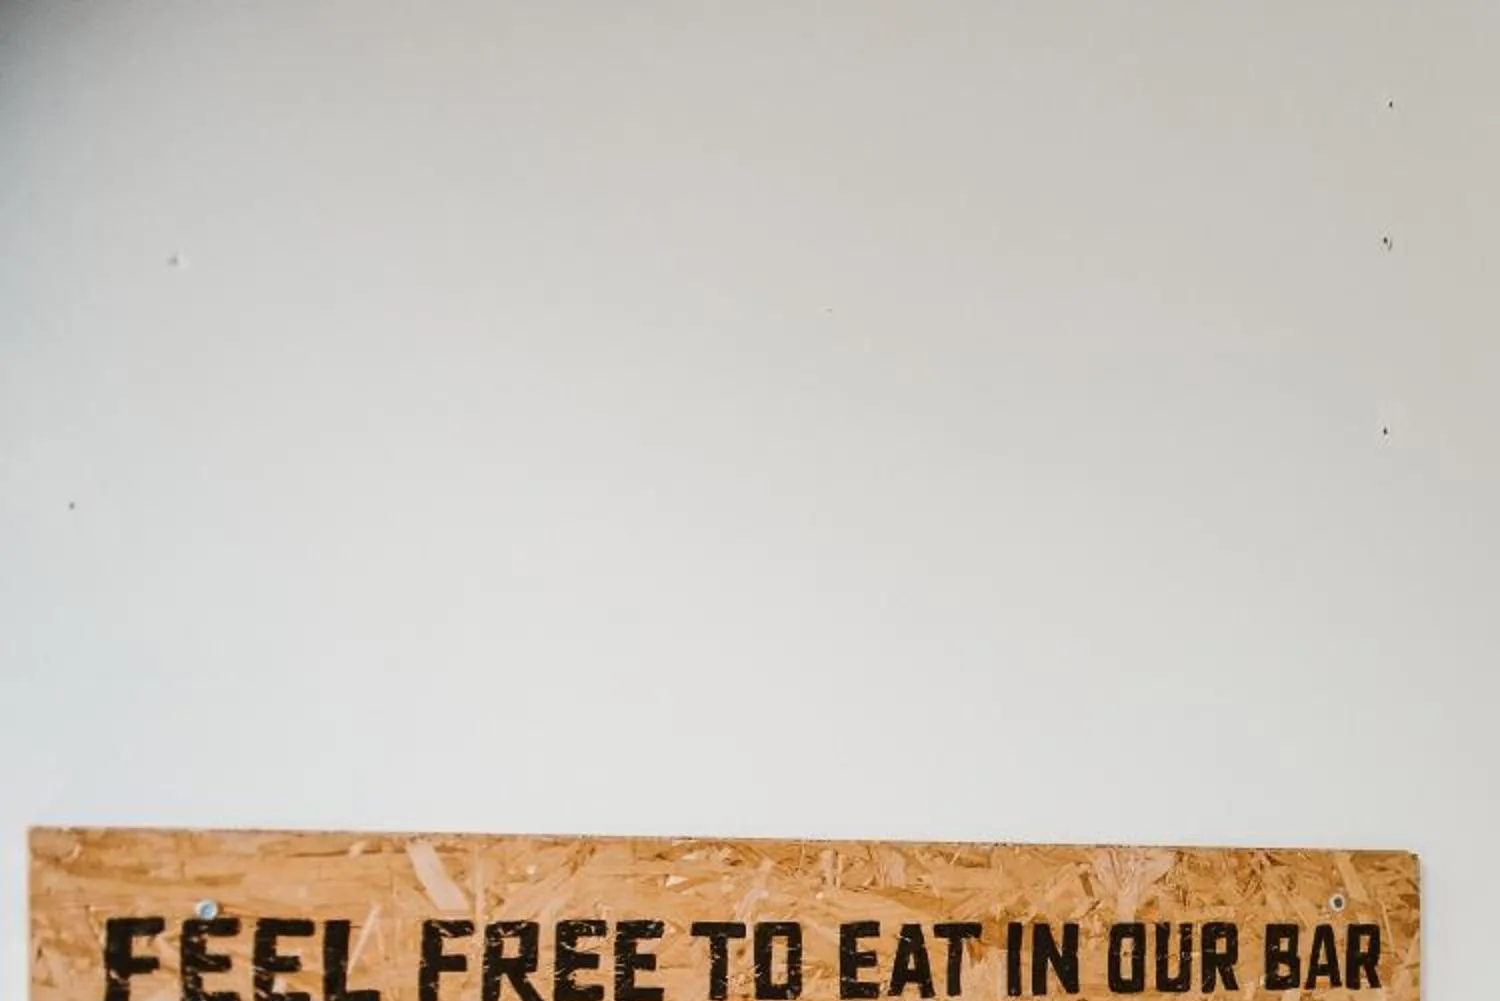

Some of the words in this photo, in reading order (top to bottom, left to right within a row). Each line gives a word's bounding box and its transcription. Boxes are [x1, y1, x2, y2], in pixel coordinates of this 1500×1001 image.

[838, 920, 984, 1000] EAT
[1006, 921, 1080, 997] IN
[1107, 920, 1240, 994] OUR
[1264, 922, 1382, 992] BAR
